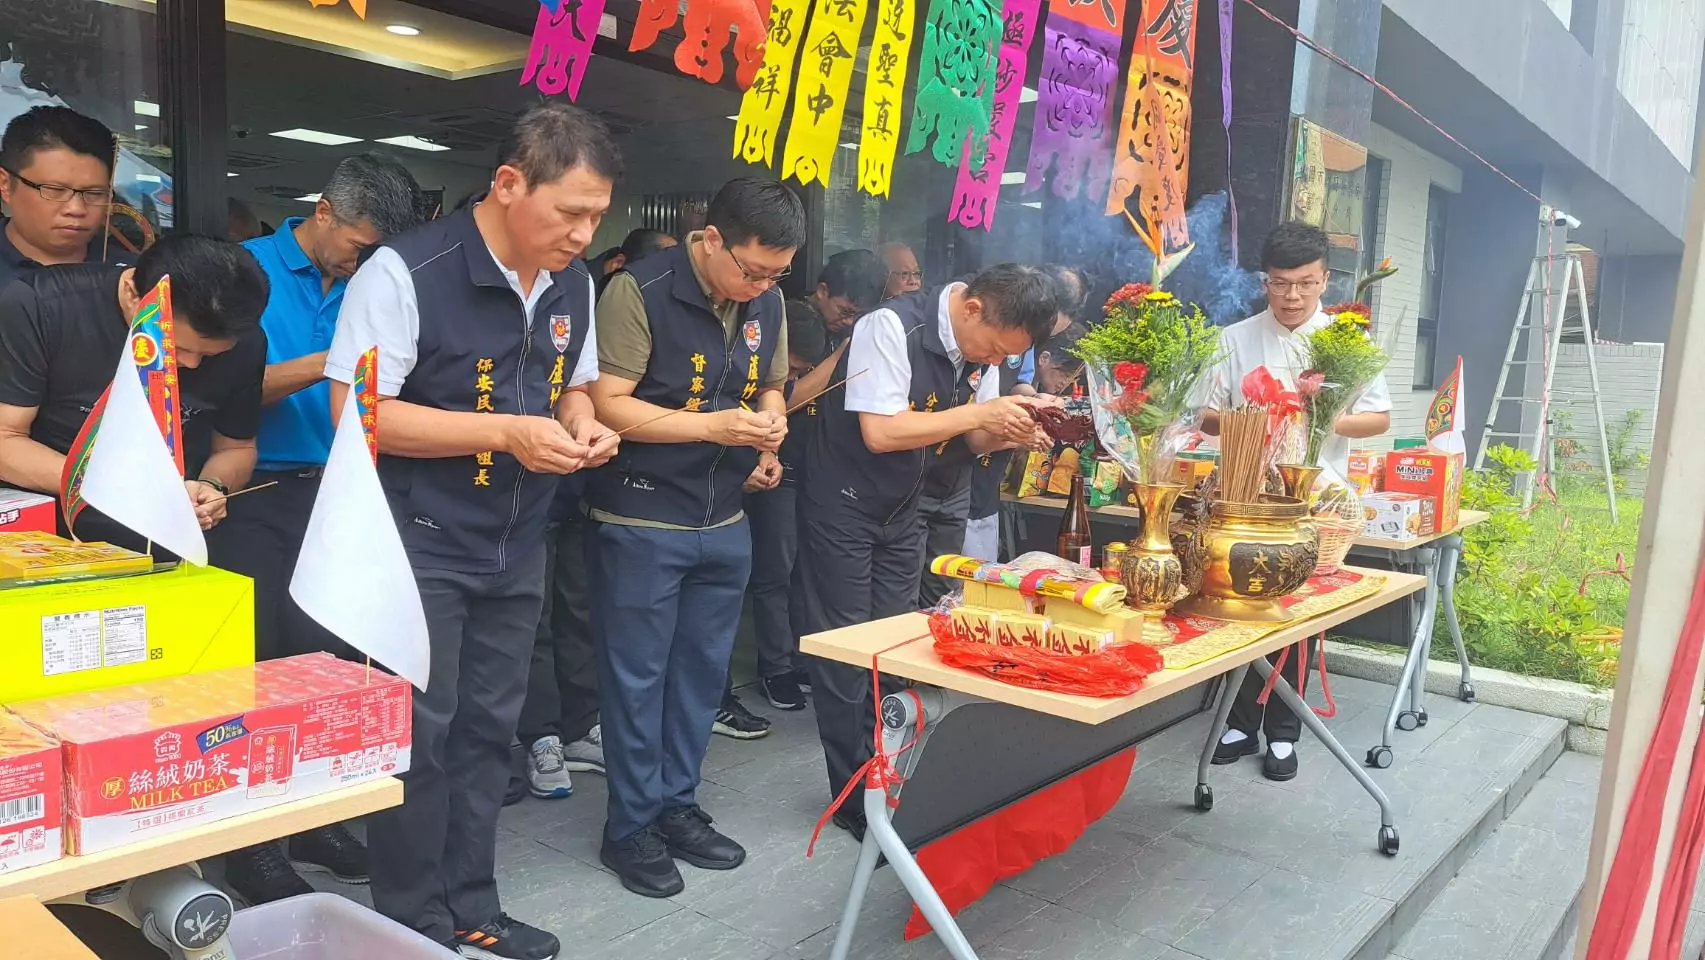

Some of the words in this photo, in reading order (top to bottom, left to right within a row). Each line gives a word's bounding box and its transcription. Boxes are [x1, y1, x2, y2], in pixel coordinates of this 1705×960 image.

[547, 355, 564, 420] 蘆竹
[741, 355, 760, 412] 蘆竹
[474, 358, 495, 486] 保安民組長
[104, 779, 122, 797] 厚
[128, 752, 231, 795] 絲絨奶茶
[130, 785, 184, 810] MILK
[189, 776, 229, 797] TEA
[207, 913, 229, 943] PRESS
